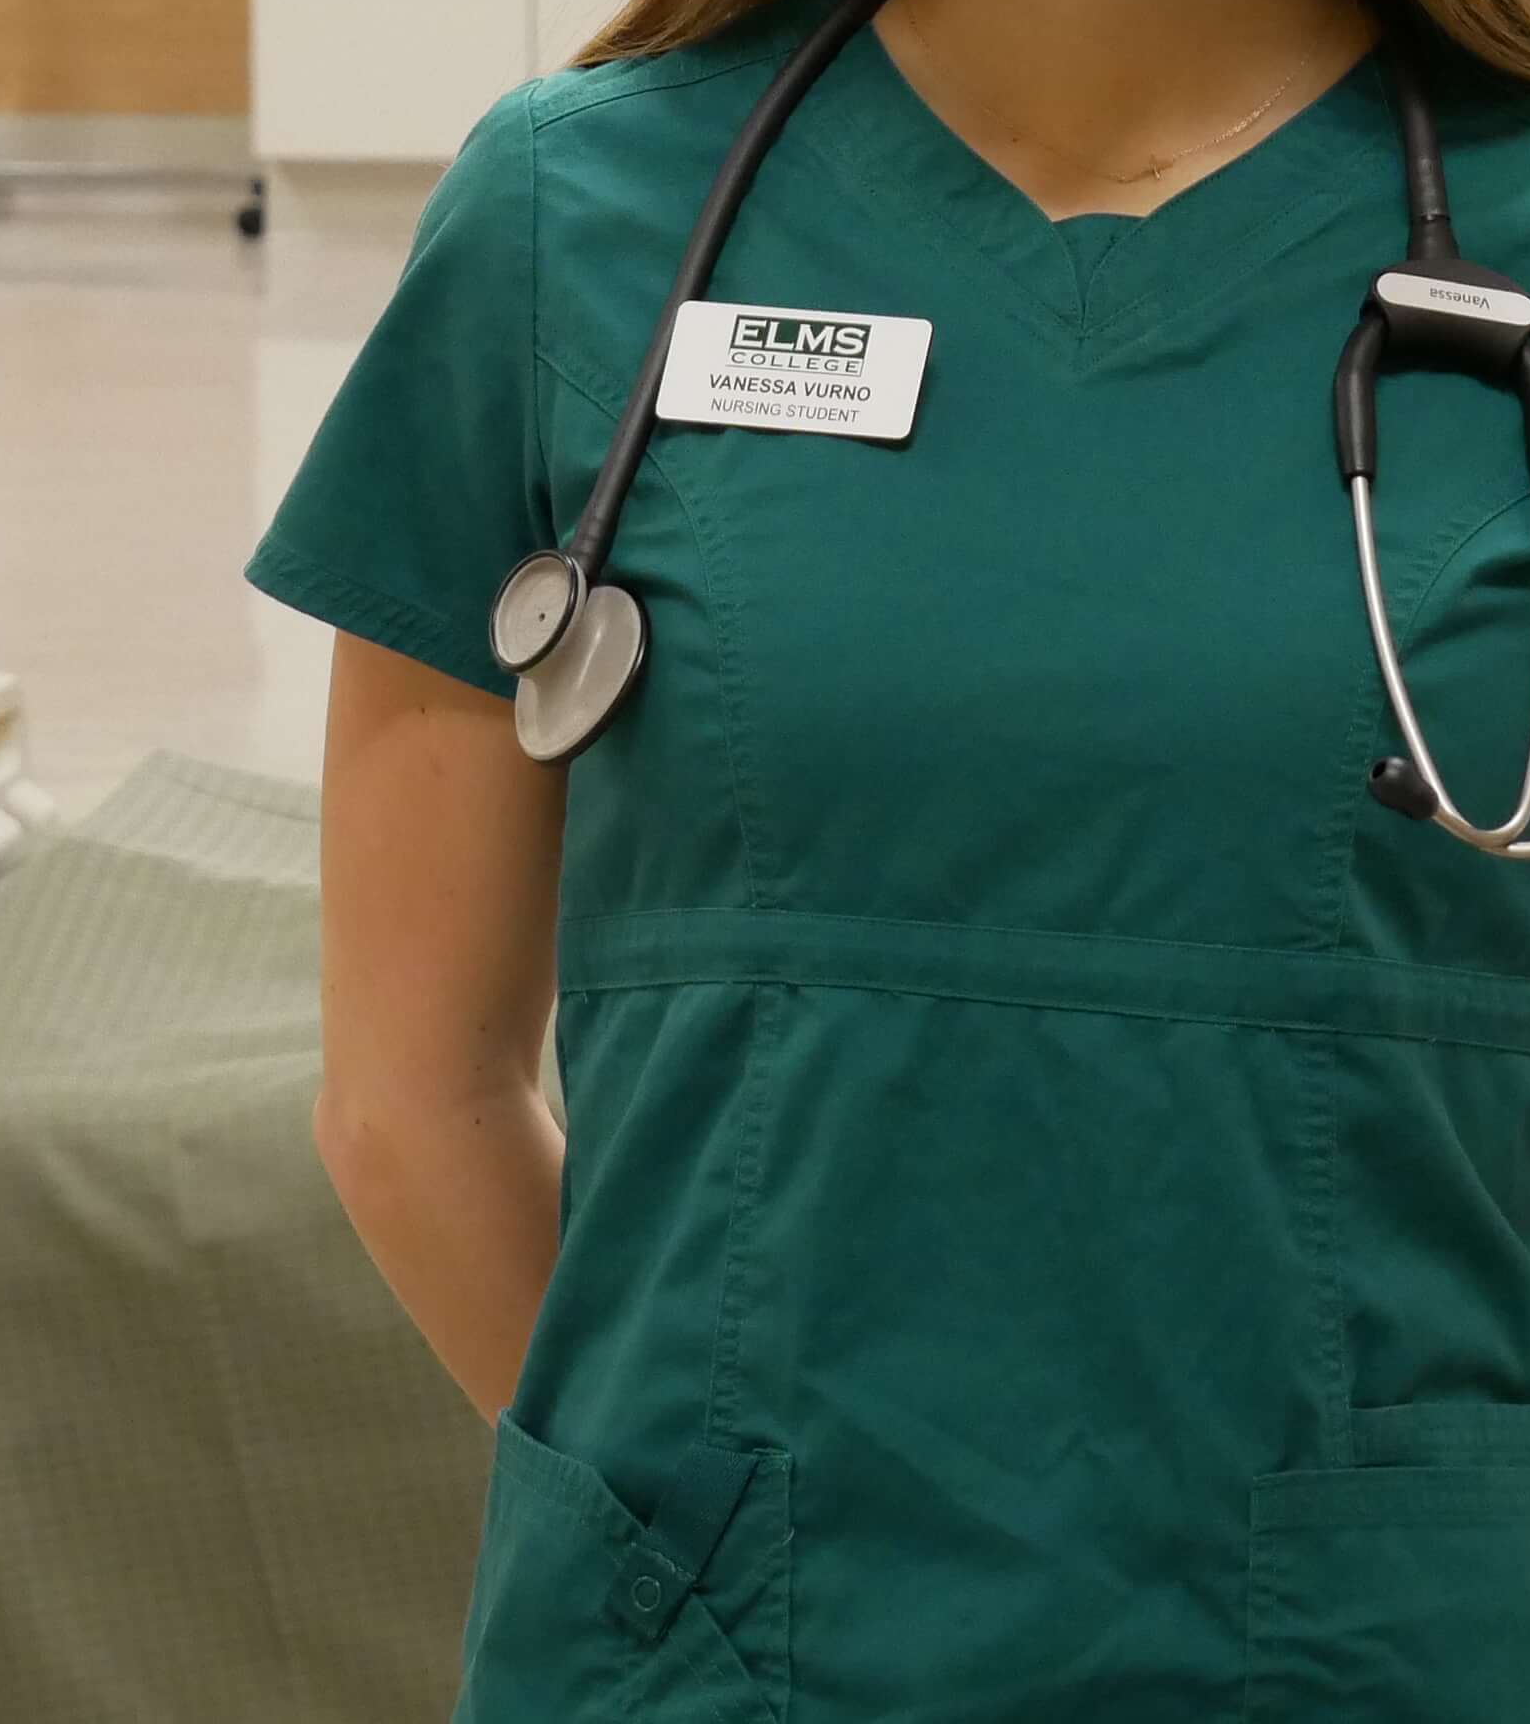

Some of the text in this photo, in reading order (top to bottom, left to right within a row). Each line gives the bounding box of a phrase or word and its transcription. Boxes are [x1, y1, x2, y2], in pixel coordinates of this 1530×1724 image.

[1429, 287, 1490, 309] Vanessa
[732, 318, 867, 355] ELMS
[731, 352, 860, 373] COLLEGE
[709, 373, 871, 402] VANESSA VURNO
[710, 397, 859, 423] NURSING STUDENT
